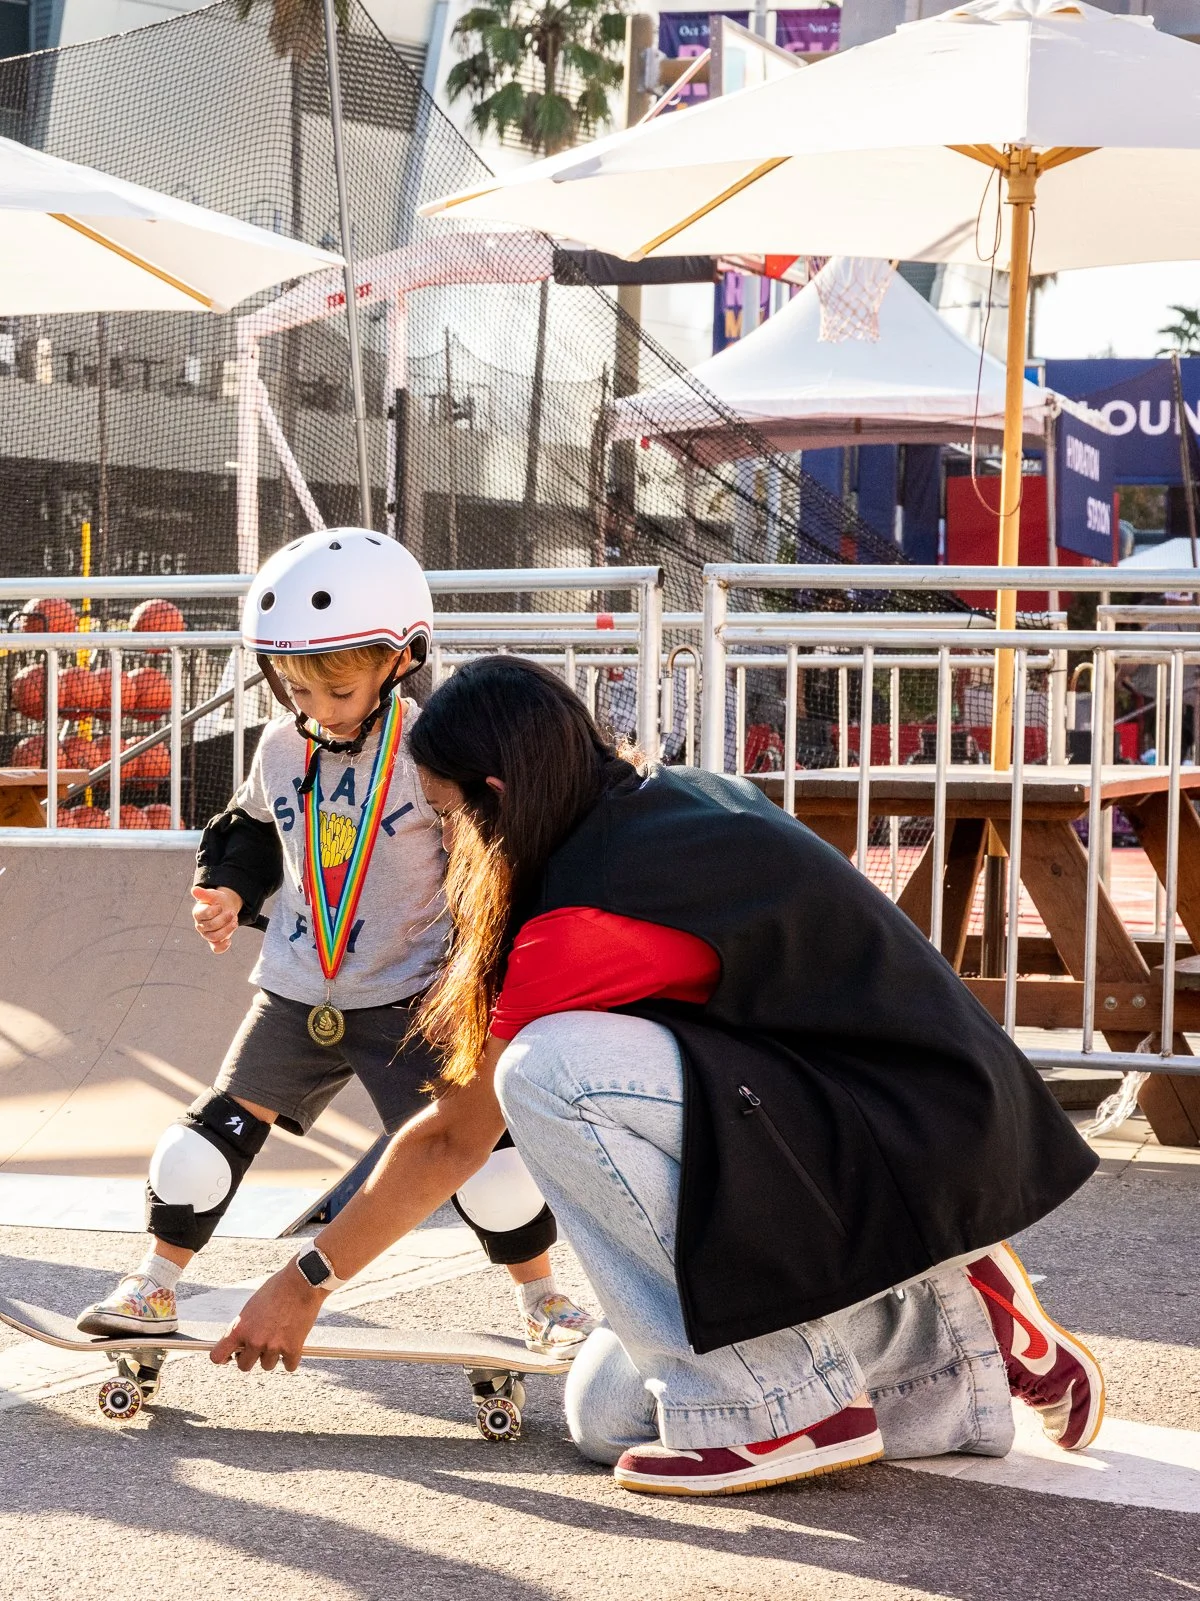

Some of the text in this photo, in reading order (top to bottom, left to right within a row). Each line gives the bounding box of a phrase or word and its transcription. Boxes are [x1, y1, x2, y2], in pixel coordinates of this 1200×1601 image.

[679, 24, 698, 37] Oct
[1079, 399, 1200, 436] OUN
[273, 766, 415, 837] SAL
